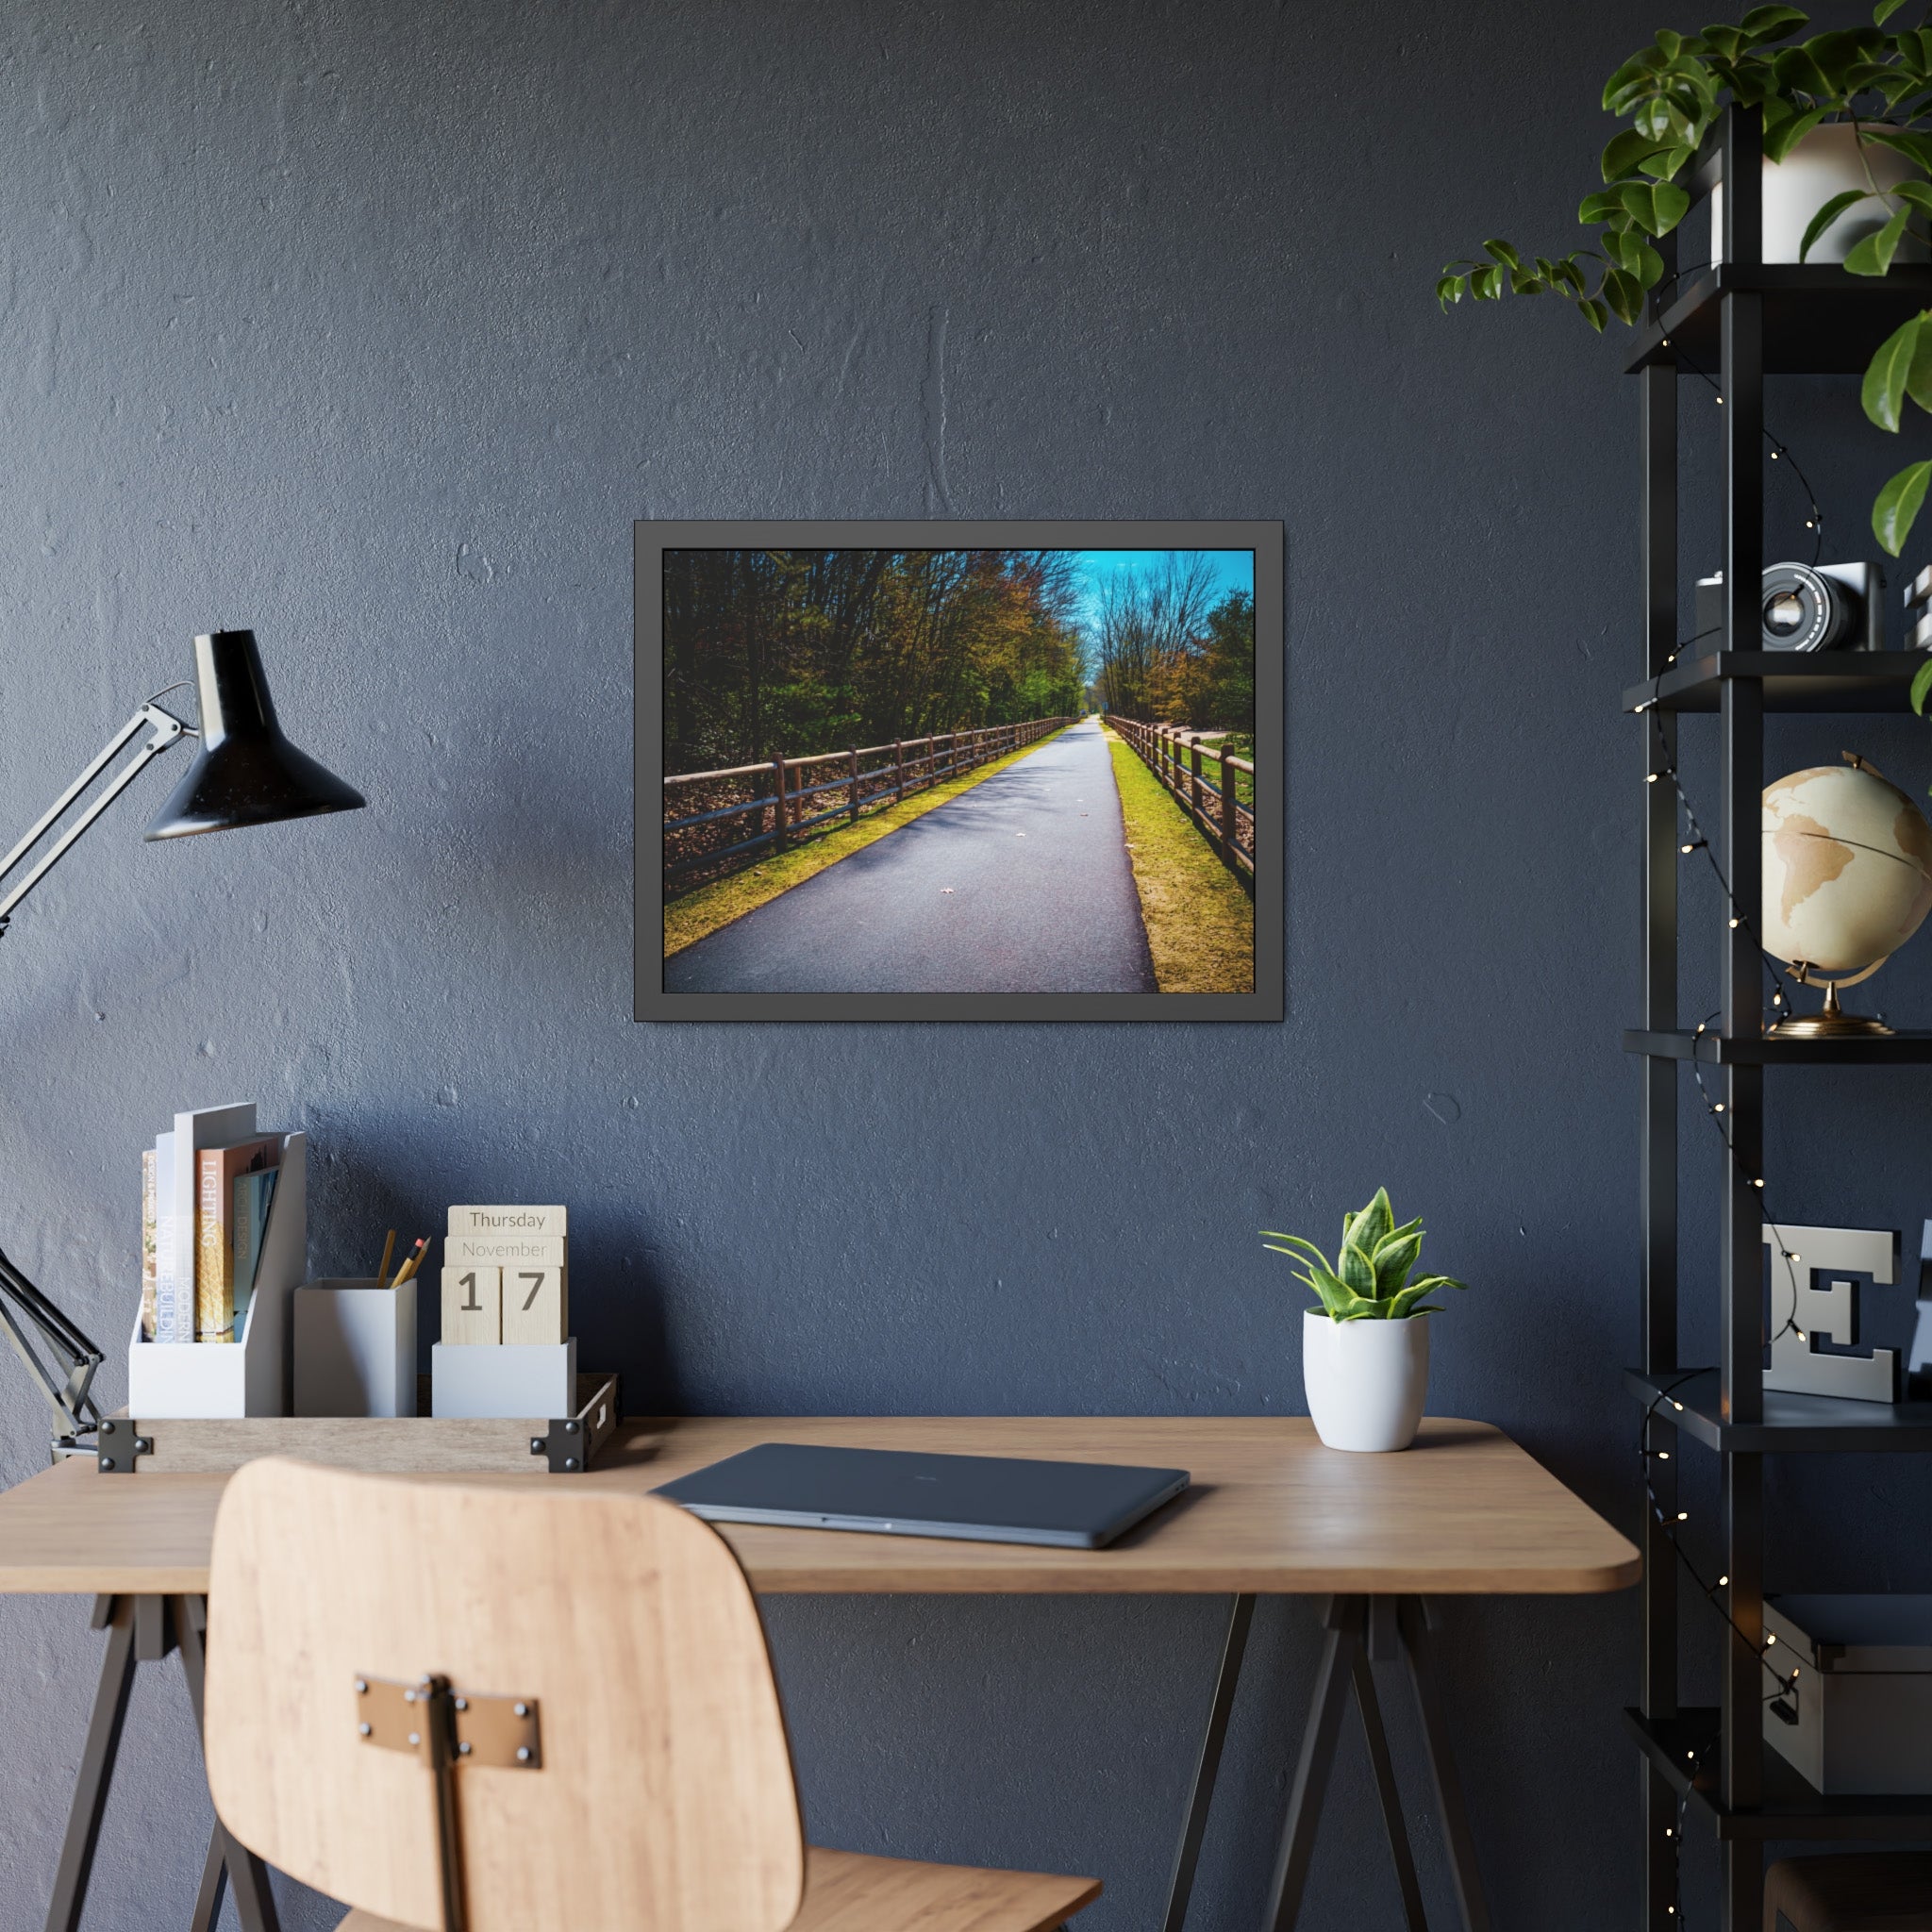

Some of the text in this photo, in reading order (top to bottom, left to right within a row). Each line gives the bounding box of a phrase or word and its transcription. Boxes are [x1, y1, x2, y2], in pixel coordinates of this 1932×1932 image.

[202, 1161, 217, 1247] LIGHTING
[470, 1212, 545, 1229] Thursday
[238, 1216, 247, 1259] DESIGN
[462, 1242, 547, 1257] November
[178, 1276, 191, 1341] MODERN
